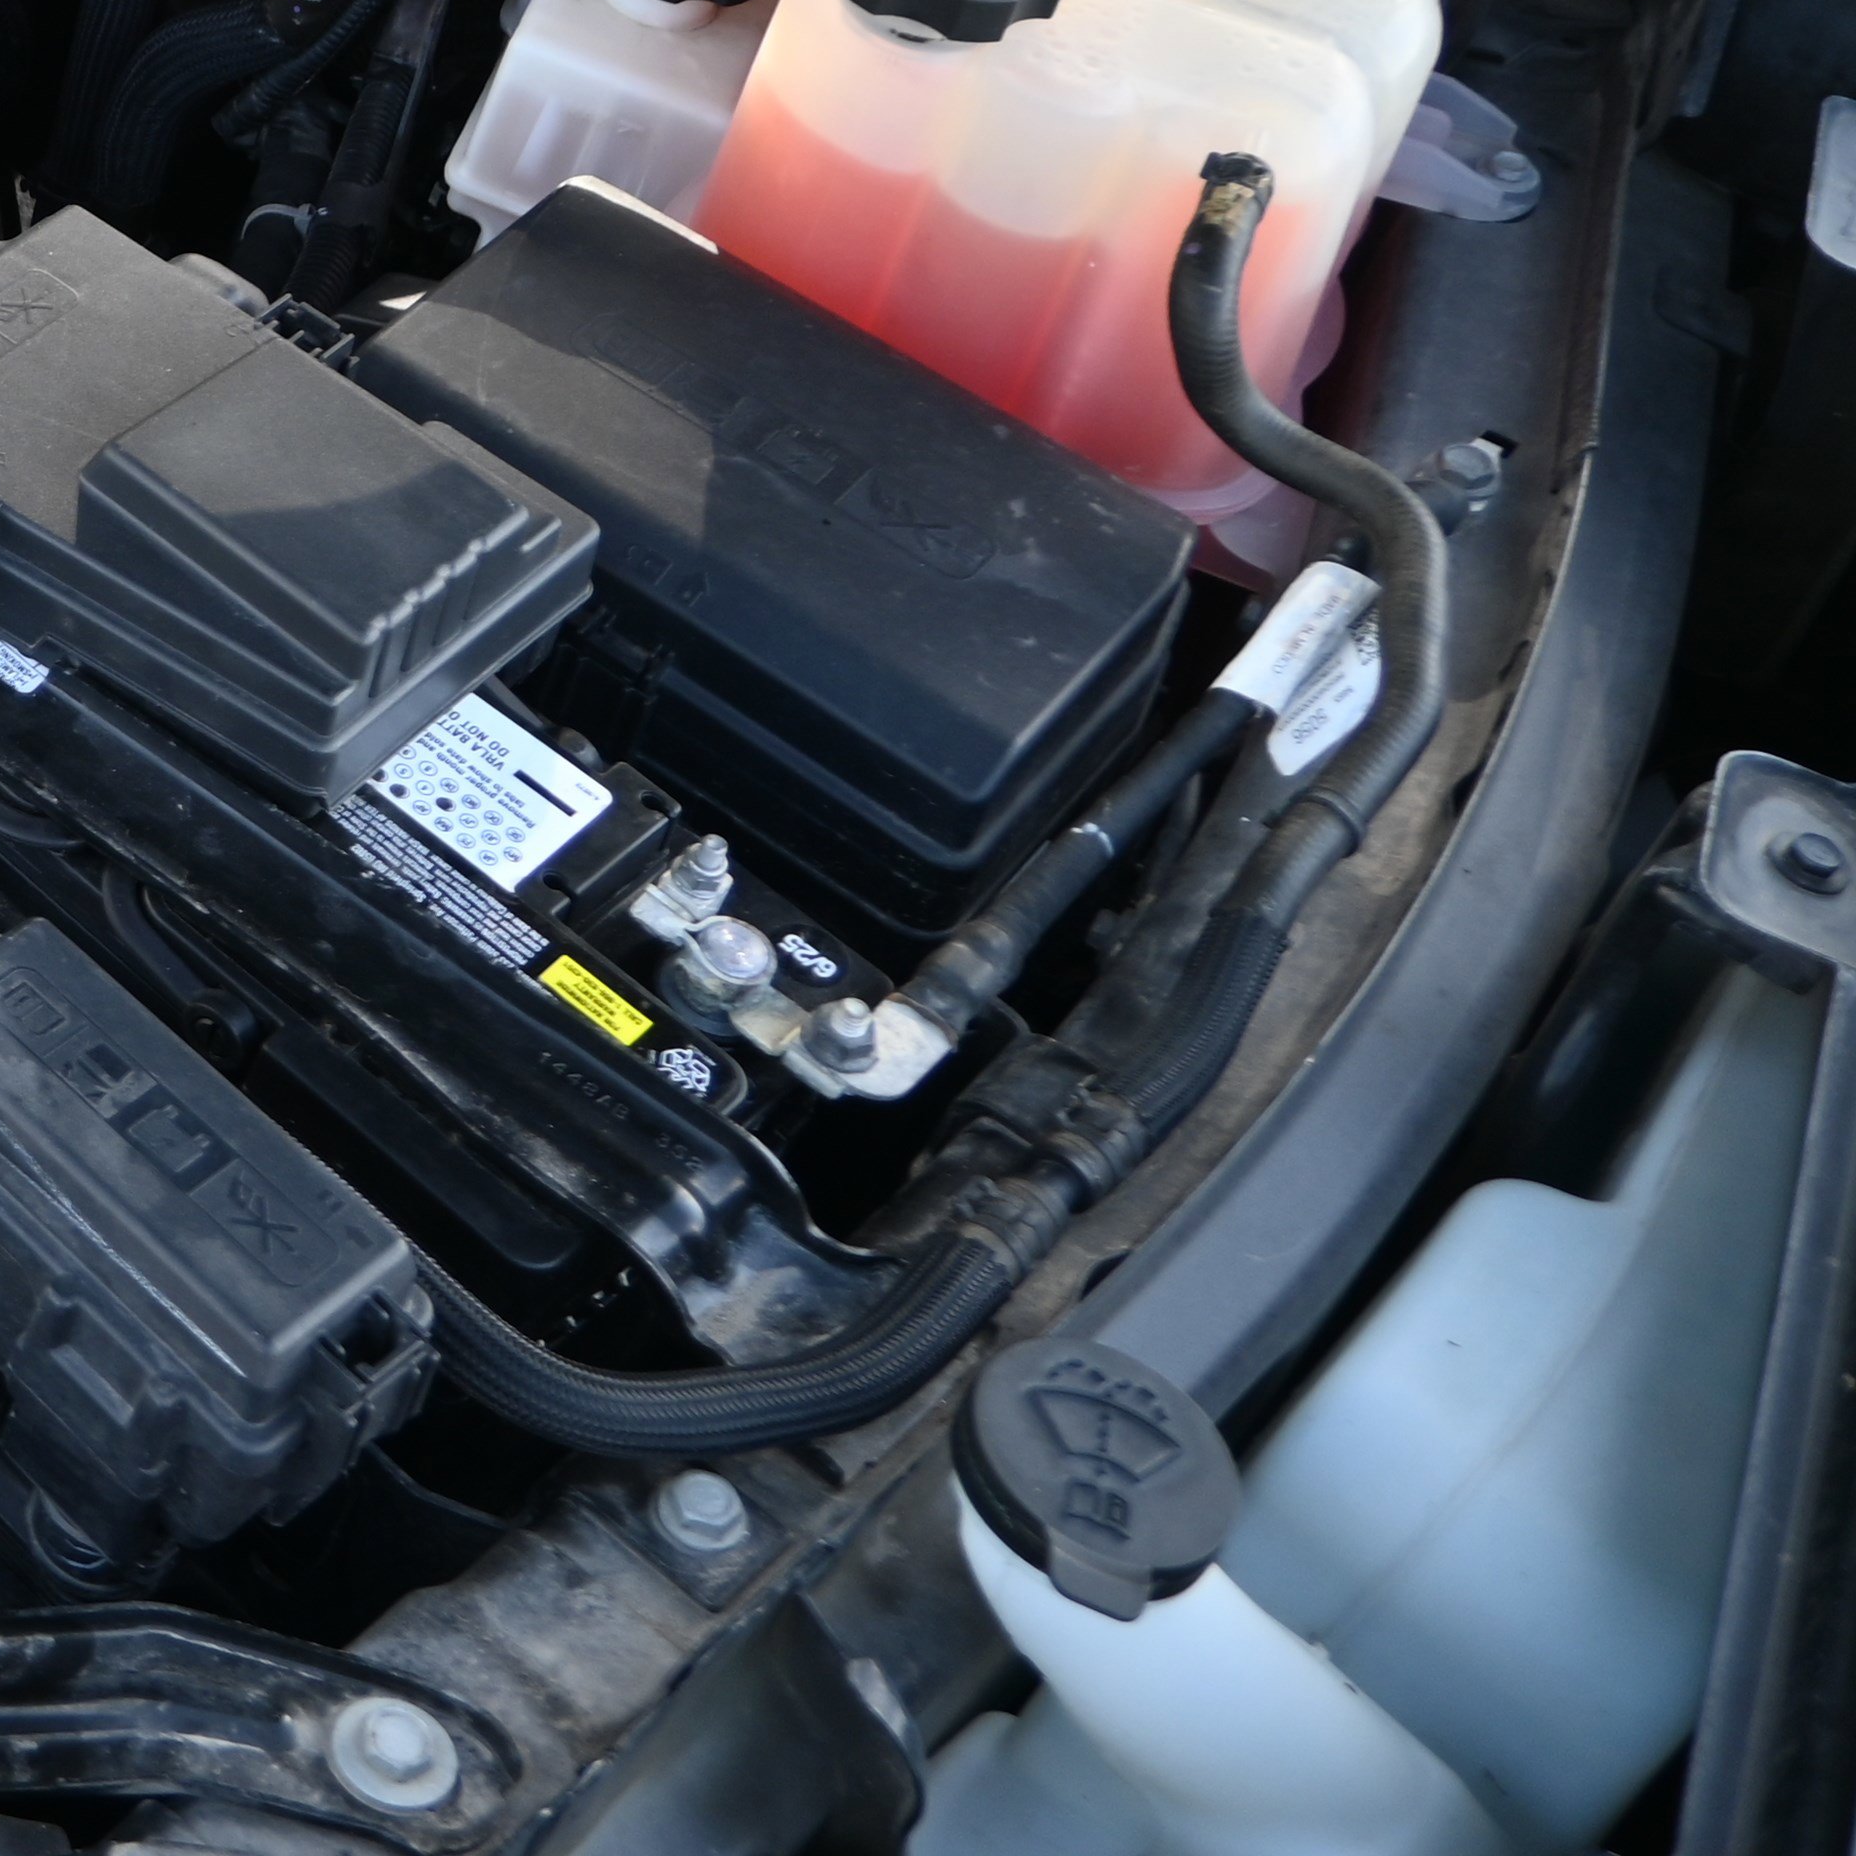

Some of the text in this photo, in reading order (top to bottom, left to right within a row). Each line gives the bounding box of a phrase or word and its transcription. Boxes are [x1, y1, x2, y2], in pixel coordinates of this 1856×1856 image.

[459, 718, 488, 743] NOT
[445, 746, 468, 766] date
[468, 740, 503, 771] VRLA
[487, 738, 509, 757] DO
[415, 736, 535, 829] Remove proper month and
[466, 763, 492, 784] show
[492, 782, 503, 793] to
[503, 790, 525, 809] tabs
[348, 813, 368, 830] State
[384, 866, 427, 904] Springfield
[778, 933, 837, 978] 6/25
[572, 980, 616, 1017] WARRANTY
